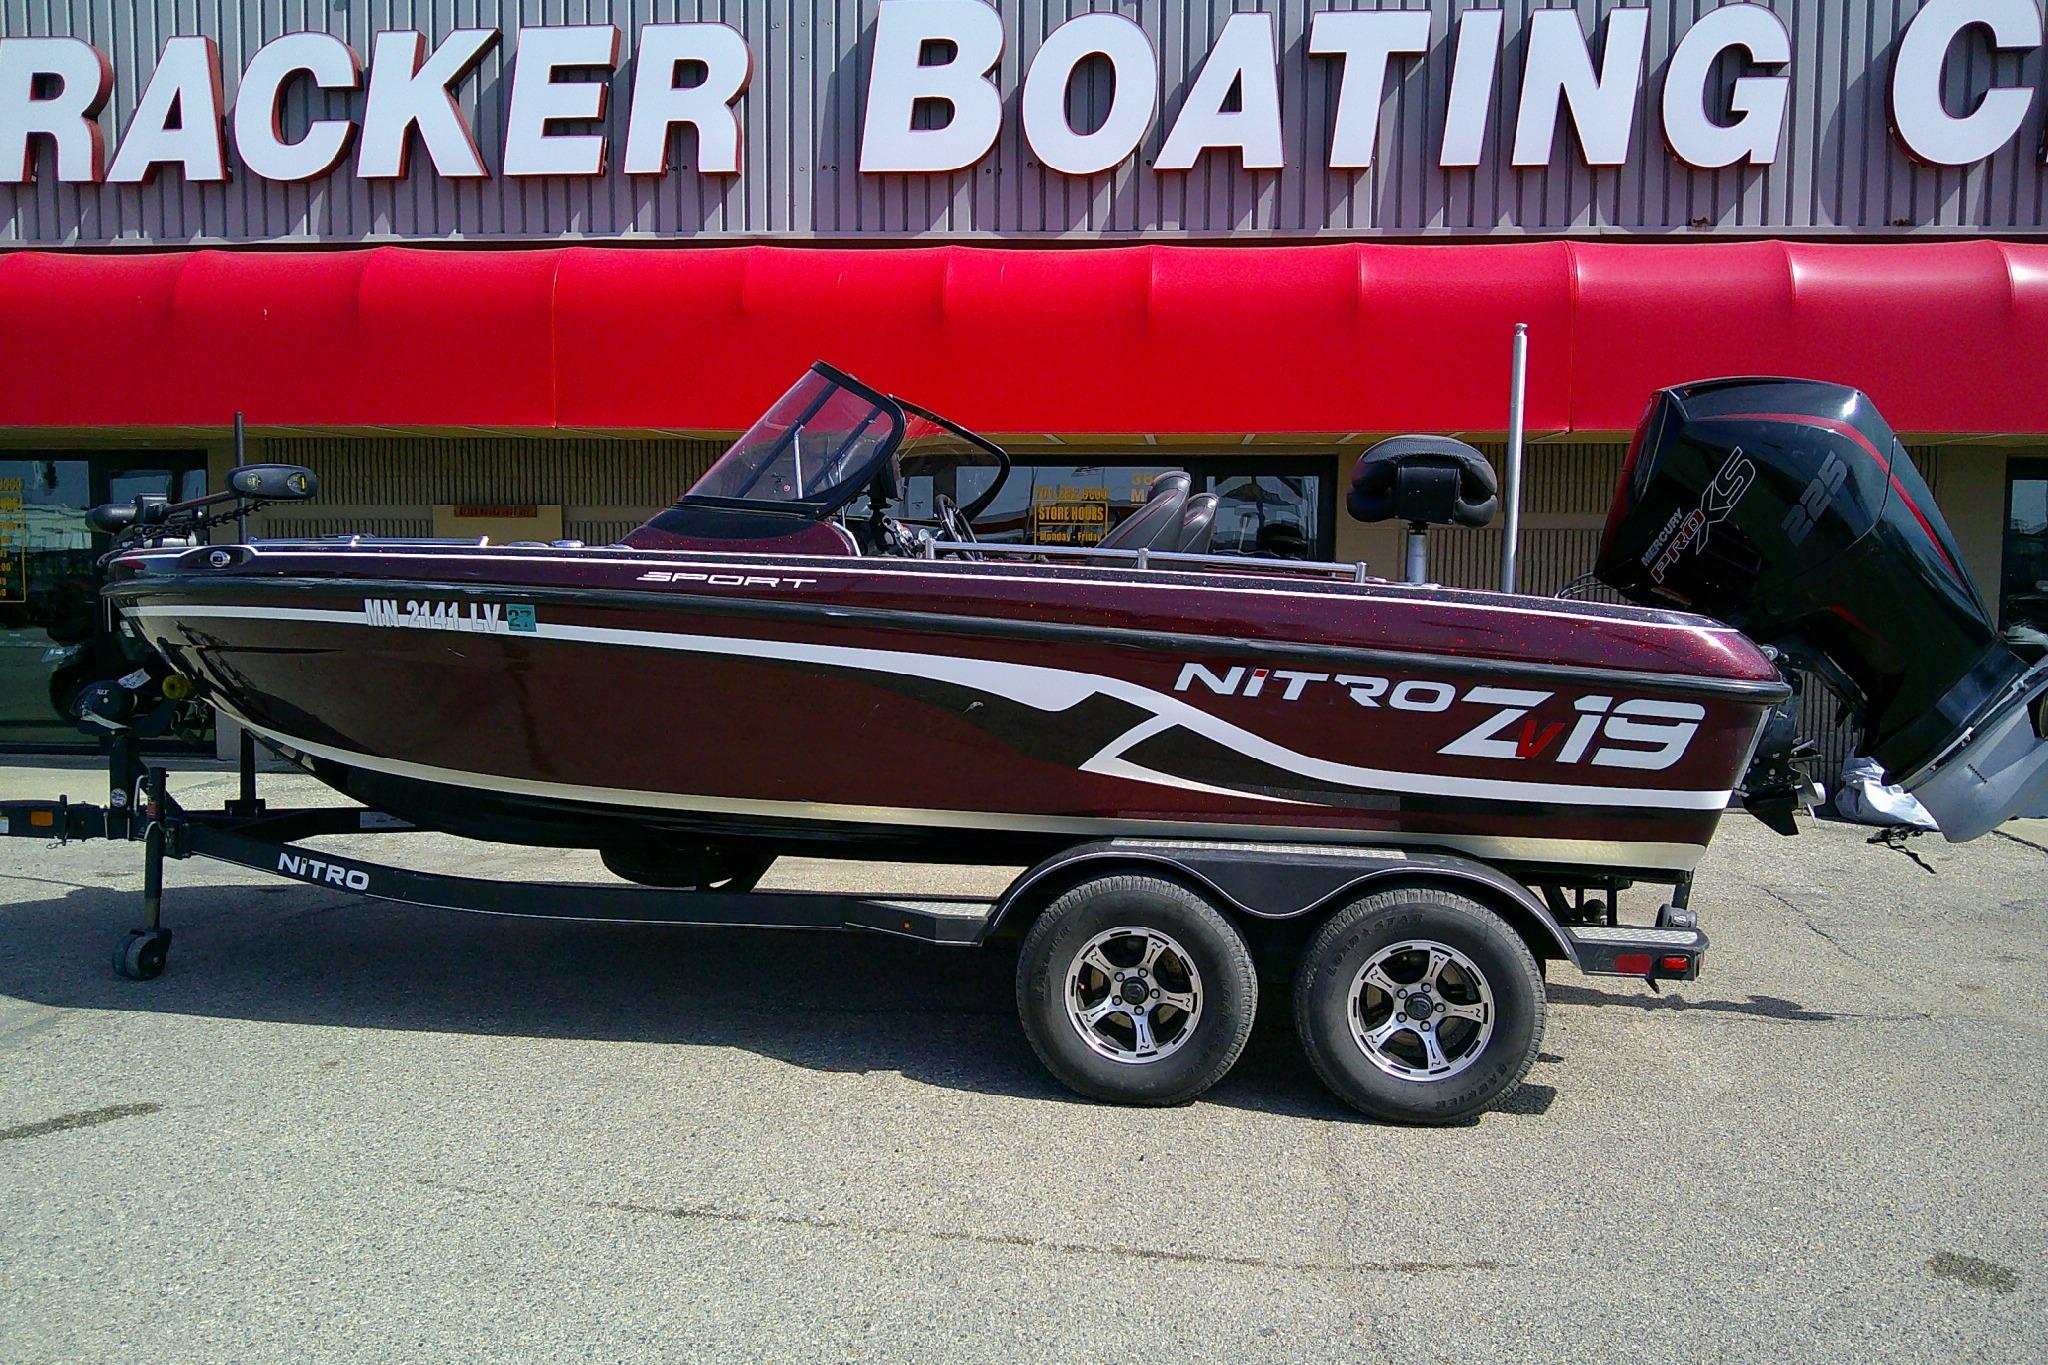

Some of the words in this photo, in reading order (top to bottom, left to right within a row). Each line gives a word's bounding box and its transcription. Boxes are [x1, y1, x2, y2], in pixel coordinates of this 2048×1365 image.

[858, 0, 1791, 176] BOATING
[1887, 0, 2048, 169] C
[1039, 506, 1069, 520] STORE
[1072, 506, 1103, 520] HOURS
[1782, 450, 1847, 547] 225
[1040, 531, 1071, 542] Monday
[1078, 530, 1101, 542] Friday
[1640, 507, 1683, 567] MERCURY
[636, 571, 817, 590] SPORT
[364, 599, 400, 628] MN
[406, 600, 460, 631] 2141
[470, 602, 501, 632] LV
